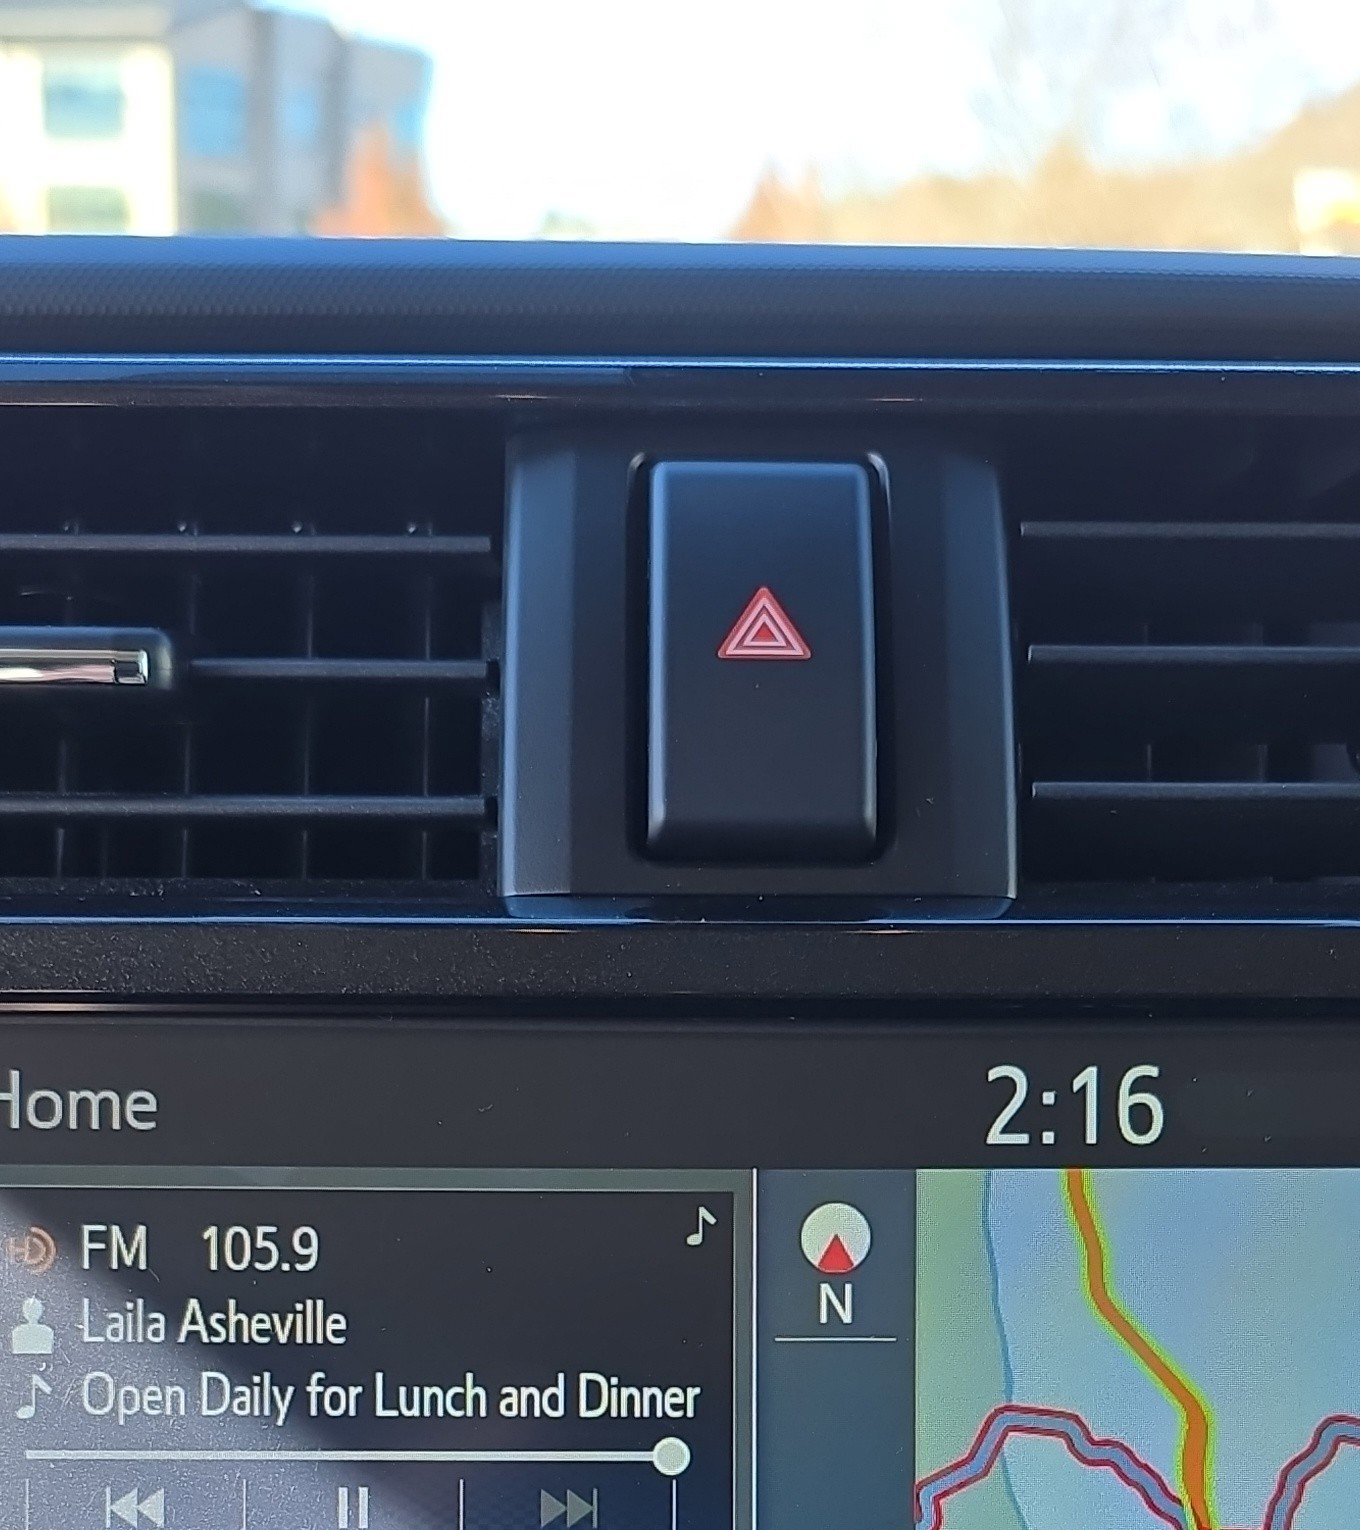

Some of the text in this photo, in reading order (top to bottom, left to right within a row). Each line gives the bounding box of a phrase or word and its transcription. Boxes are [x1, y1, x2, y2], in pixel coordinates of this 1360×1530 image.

[985, 1064, 1164, 1146] 2:16
[80, 1224, 148, 1271] FM
[202, 1225, 320, 1272] 105.9
[82, 1297, 348, 1345] Laila Asheville
[818, 1283, 852, 1323] N
[82, 1370, 702, 1427] Open Daily for Lunch and Dinner
